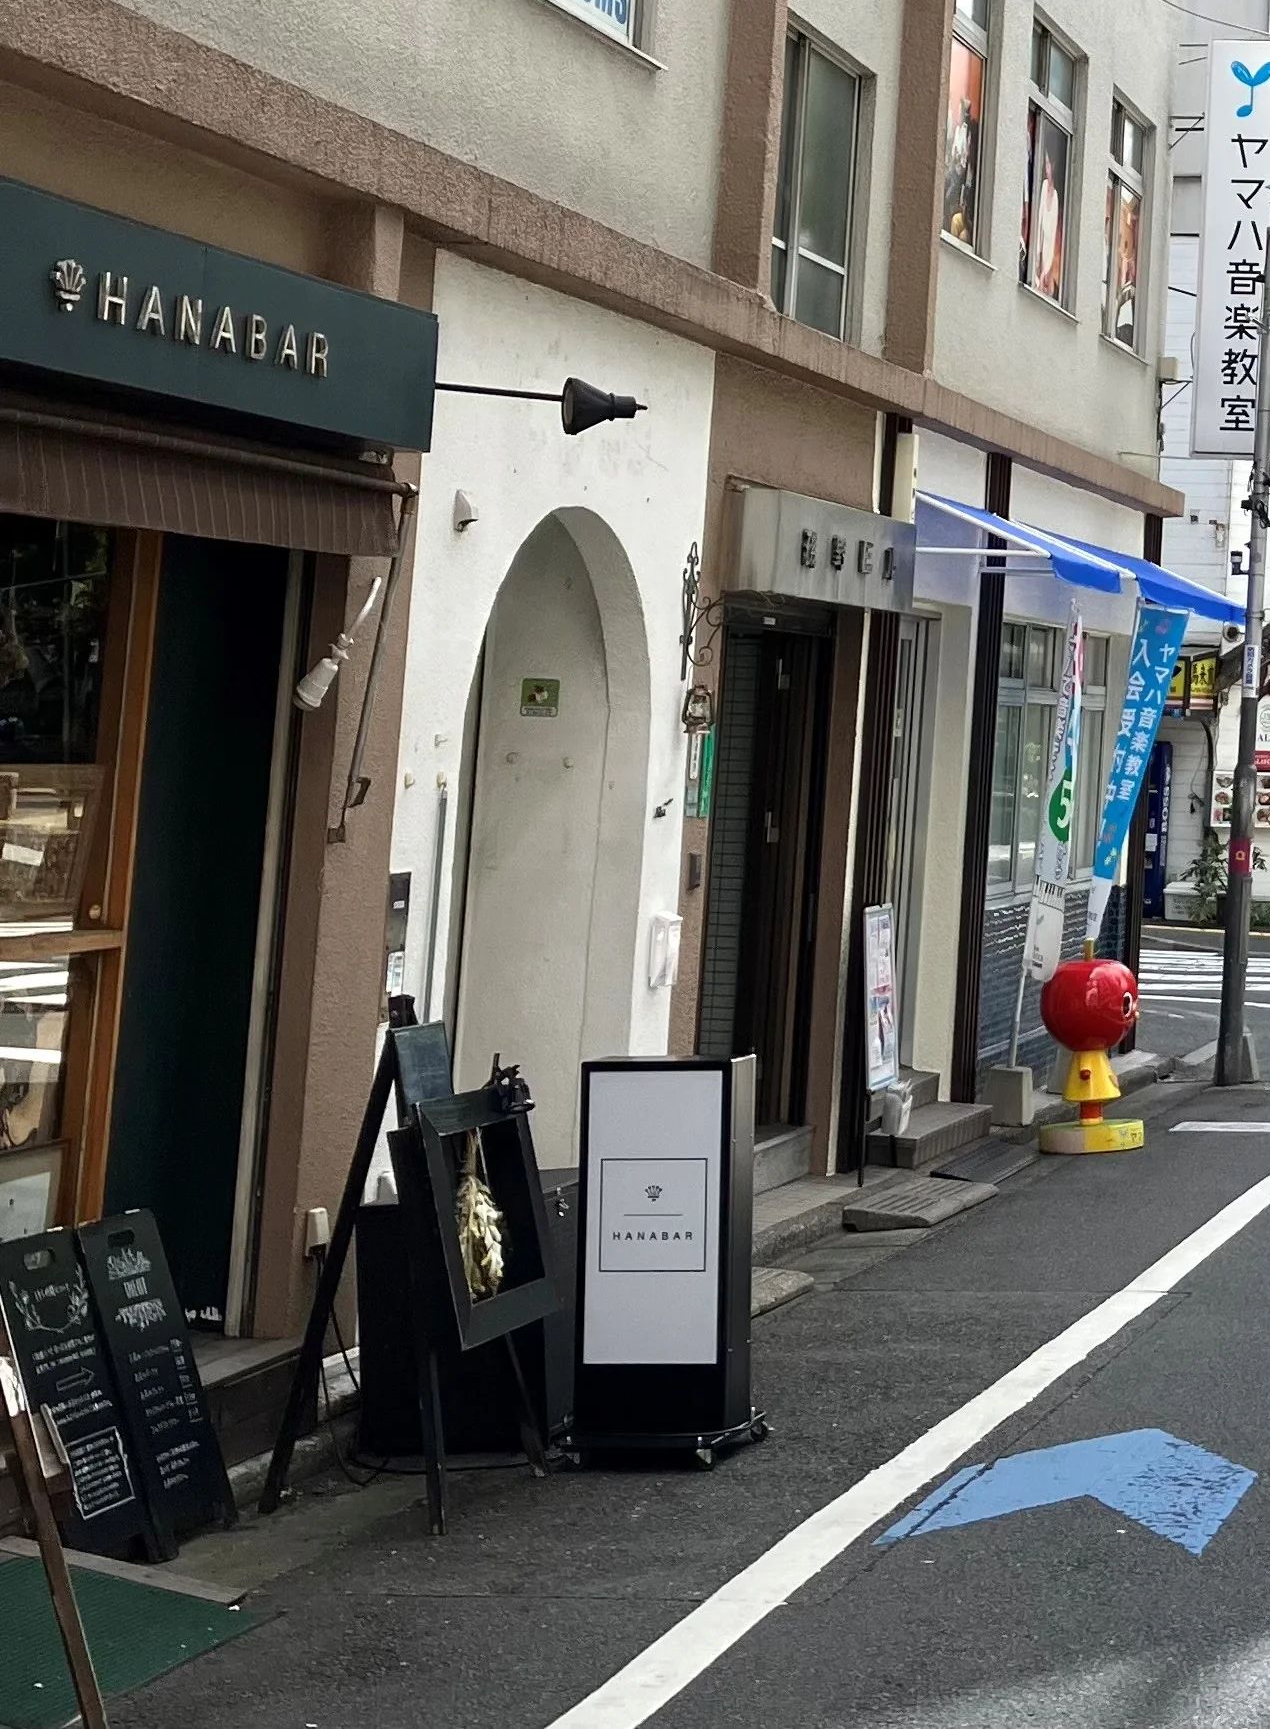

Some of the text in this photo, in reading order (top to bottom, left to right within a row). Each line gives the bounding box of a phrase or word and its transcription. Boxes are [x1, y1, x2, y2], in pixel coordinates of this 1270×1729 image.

[97, 271, 329, 379] HANABAR
[1219, 133, 1268, 432] ヤマハ音楽教室
[1117, 643, 1176, 801] ヤマハ音楽教室
[612, 1231, 693, 1241] HANABAR
